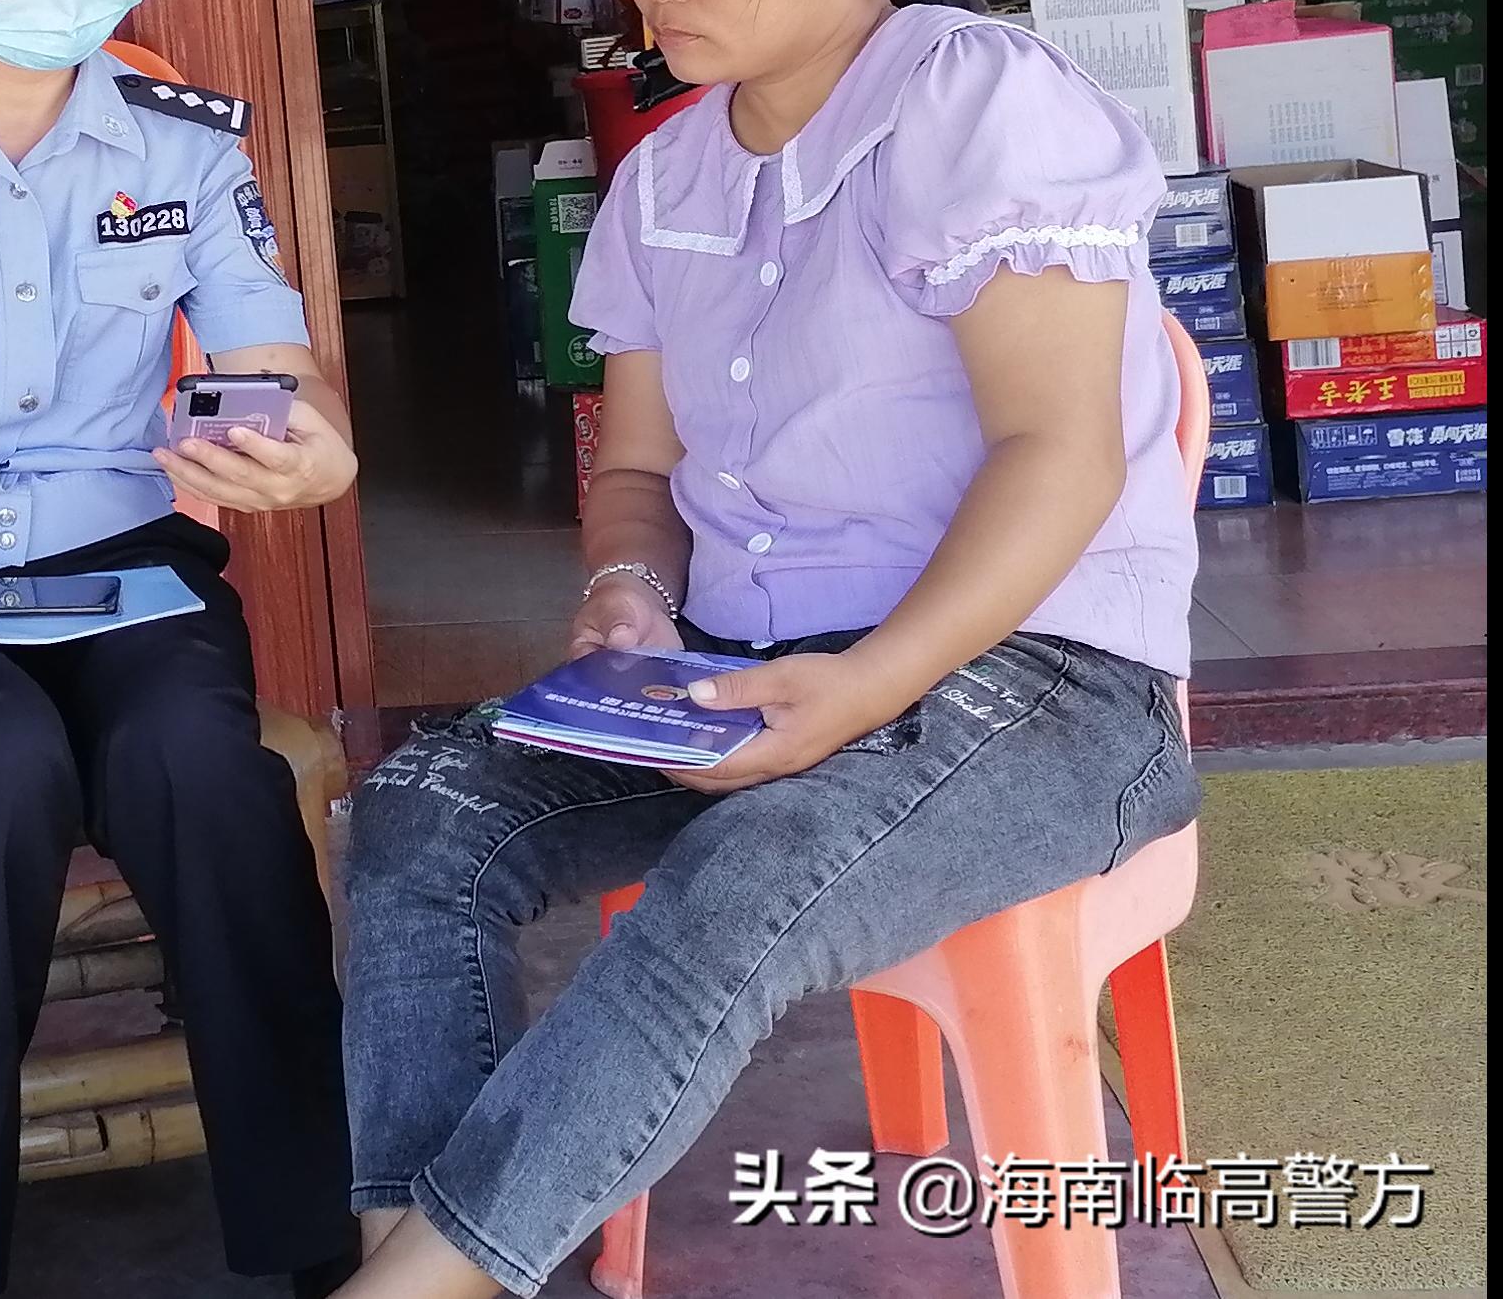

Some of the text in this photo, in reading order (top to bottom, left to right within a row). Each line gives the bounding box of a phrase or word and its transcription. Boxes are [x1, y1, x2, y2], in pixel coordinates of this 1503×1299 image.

[100, 207, 186, 237] 130228
[1317, 376, 1397, 406] 王老吉
